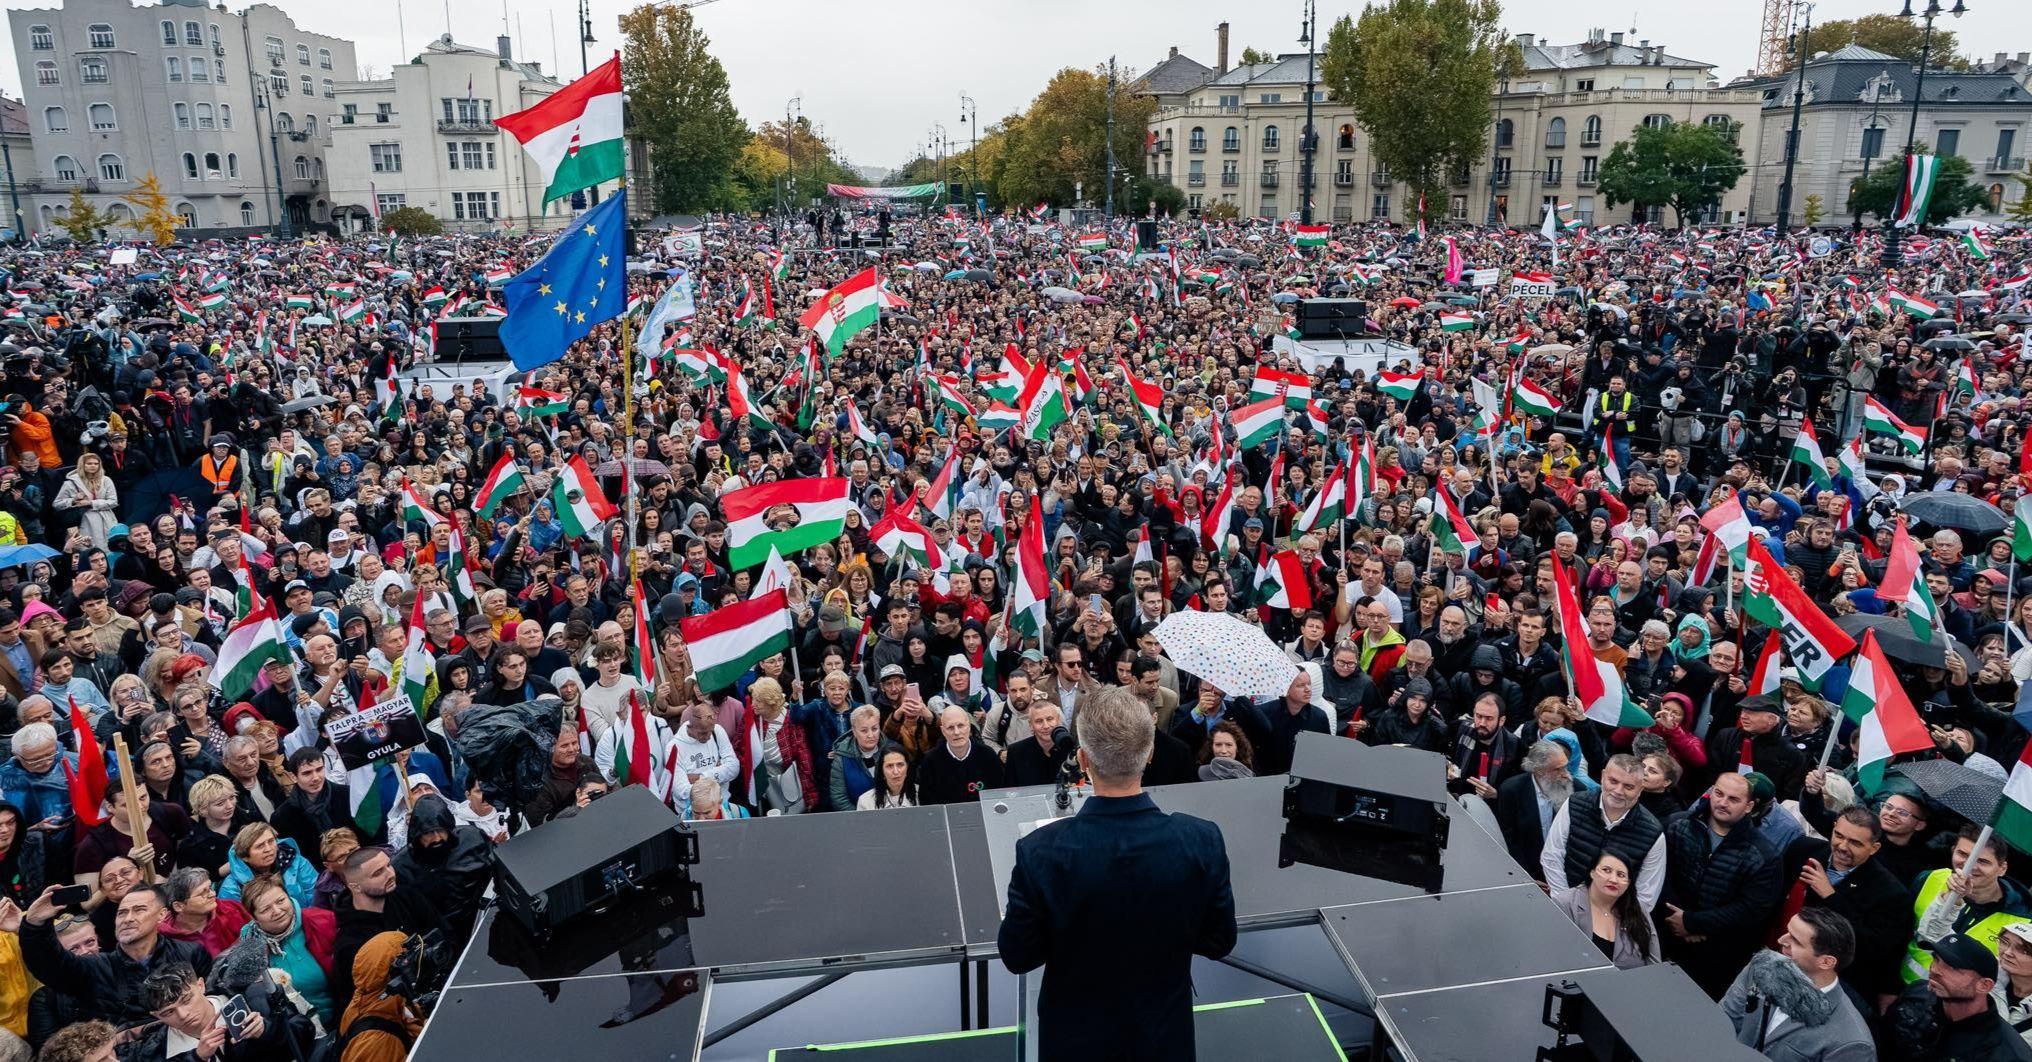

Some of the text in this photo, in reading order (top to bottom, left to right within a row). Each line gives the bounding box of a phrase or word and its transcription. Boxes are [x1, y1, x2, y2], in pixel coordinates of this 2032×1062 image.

[1512, 283, 1553, 296] PÉCEL
[1778, 607, 1822, 670] ER
[329, 697, 410, 732] TALPRA MAGYAR
[367, 742, 402, 759] GYULA
